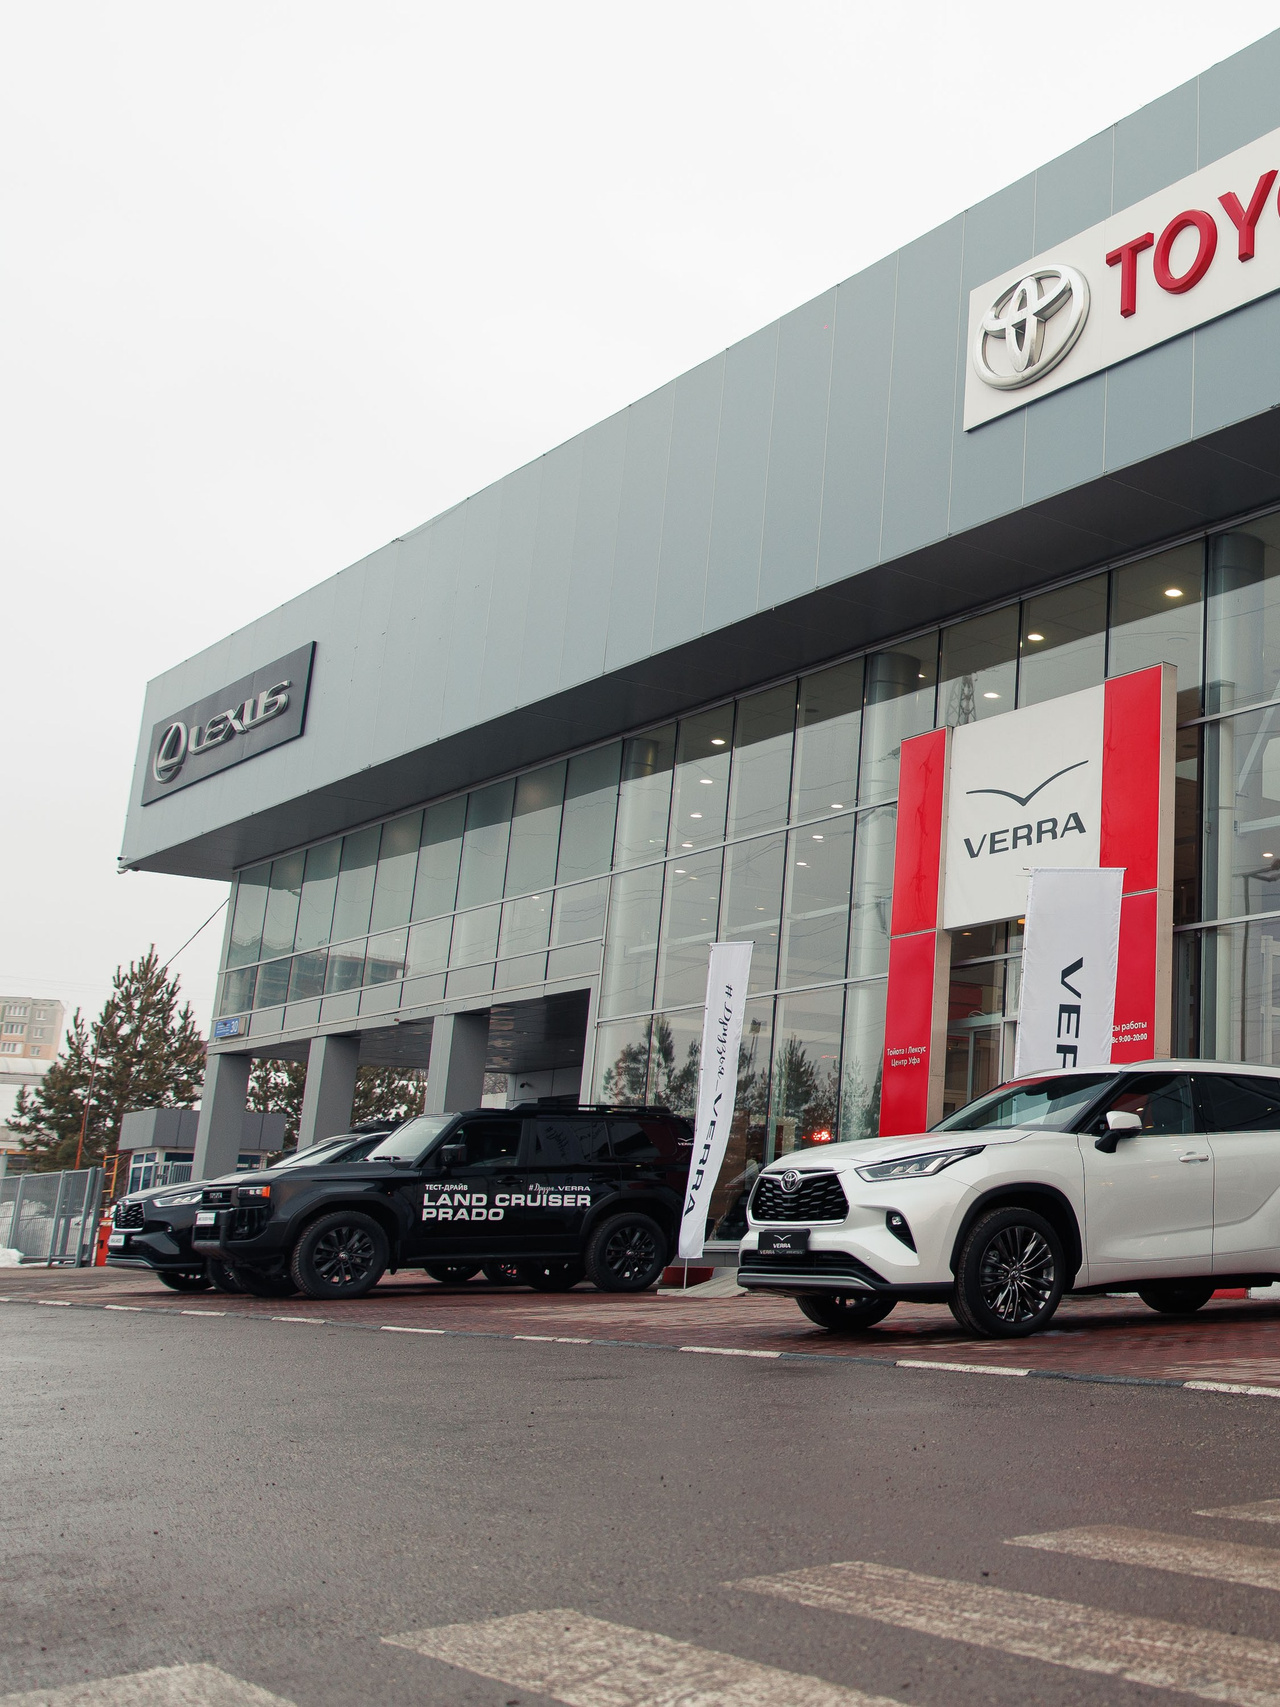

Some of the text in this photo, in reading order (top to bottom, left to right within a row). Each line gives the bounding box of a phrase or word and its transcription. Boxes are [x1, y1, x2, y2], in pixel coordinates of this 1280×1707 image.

[188, 680, 292, 755] LEXUS
[963, 812, 1087, 859] VERRA
[230, 1020, 239, 1033] 30
[1121, 1020, 1148, 1033] работы
[1119, 1033, 1148, 1043] 9:00-20:00
[887, 1046, 927, 1056] Тойота Лексус
[891, 1056, 921, 1067] Центр Уфа
[425, 1183, 468, 1192] ТЕСТ-ДРАЙВ
[423, 1193, 591, 1207] LAND CRUISER
[422, 1208, 505, 1221] PRADO
